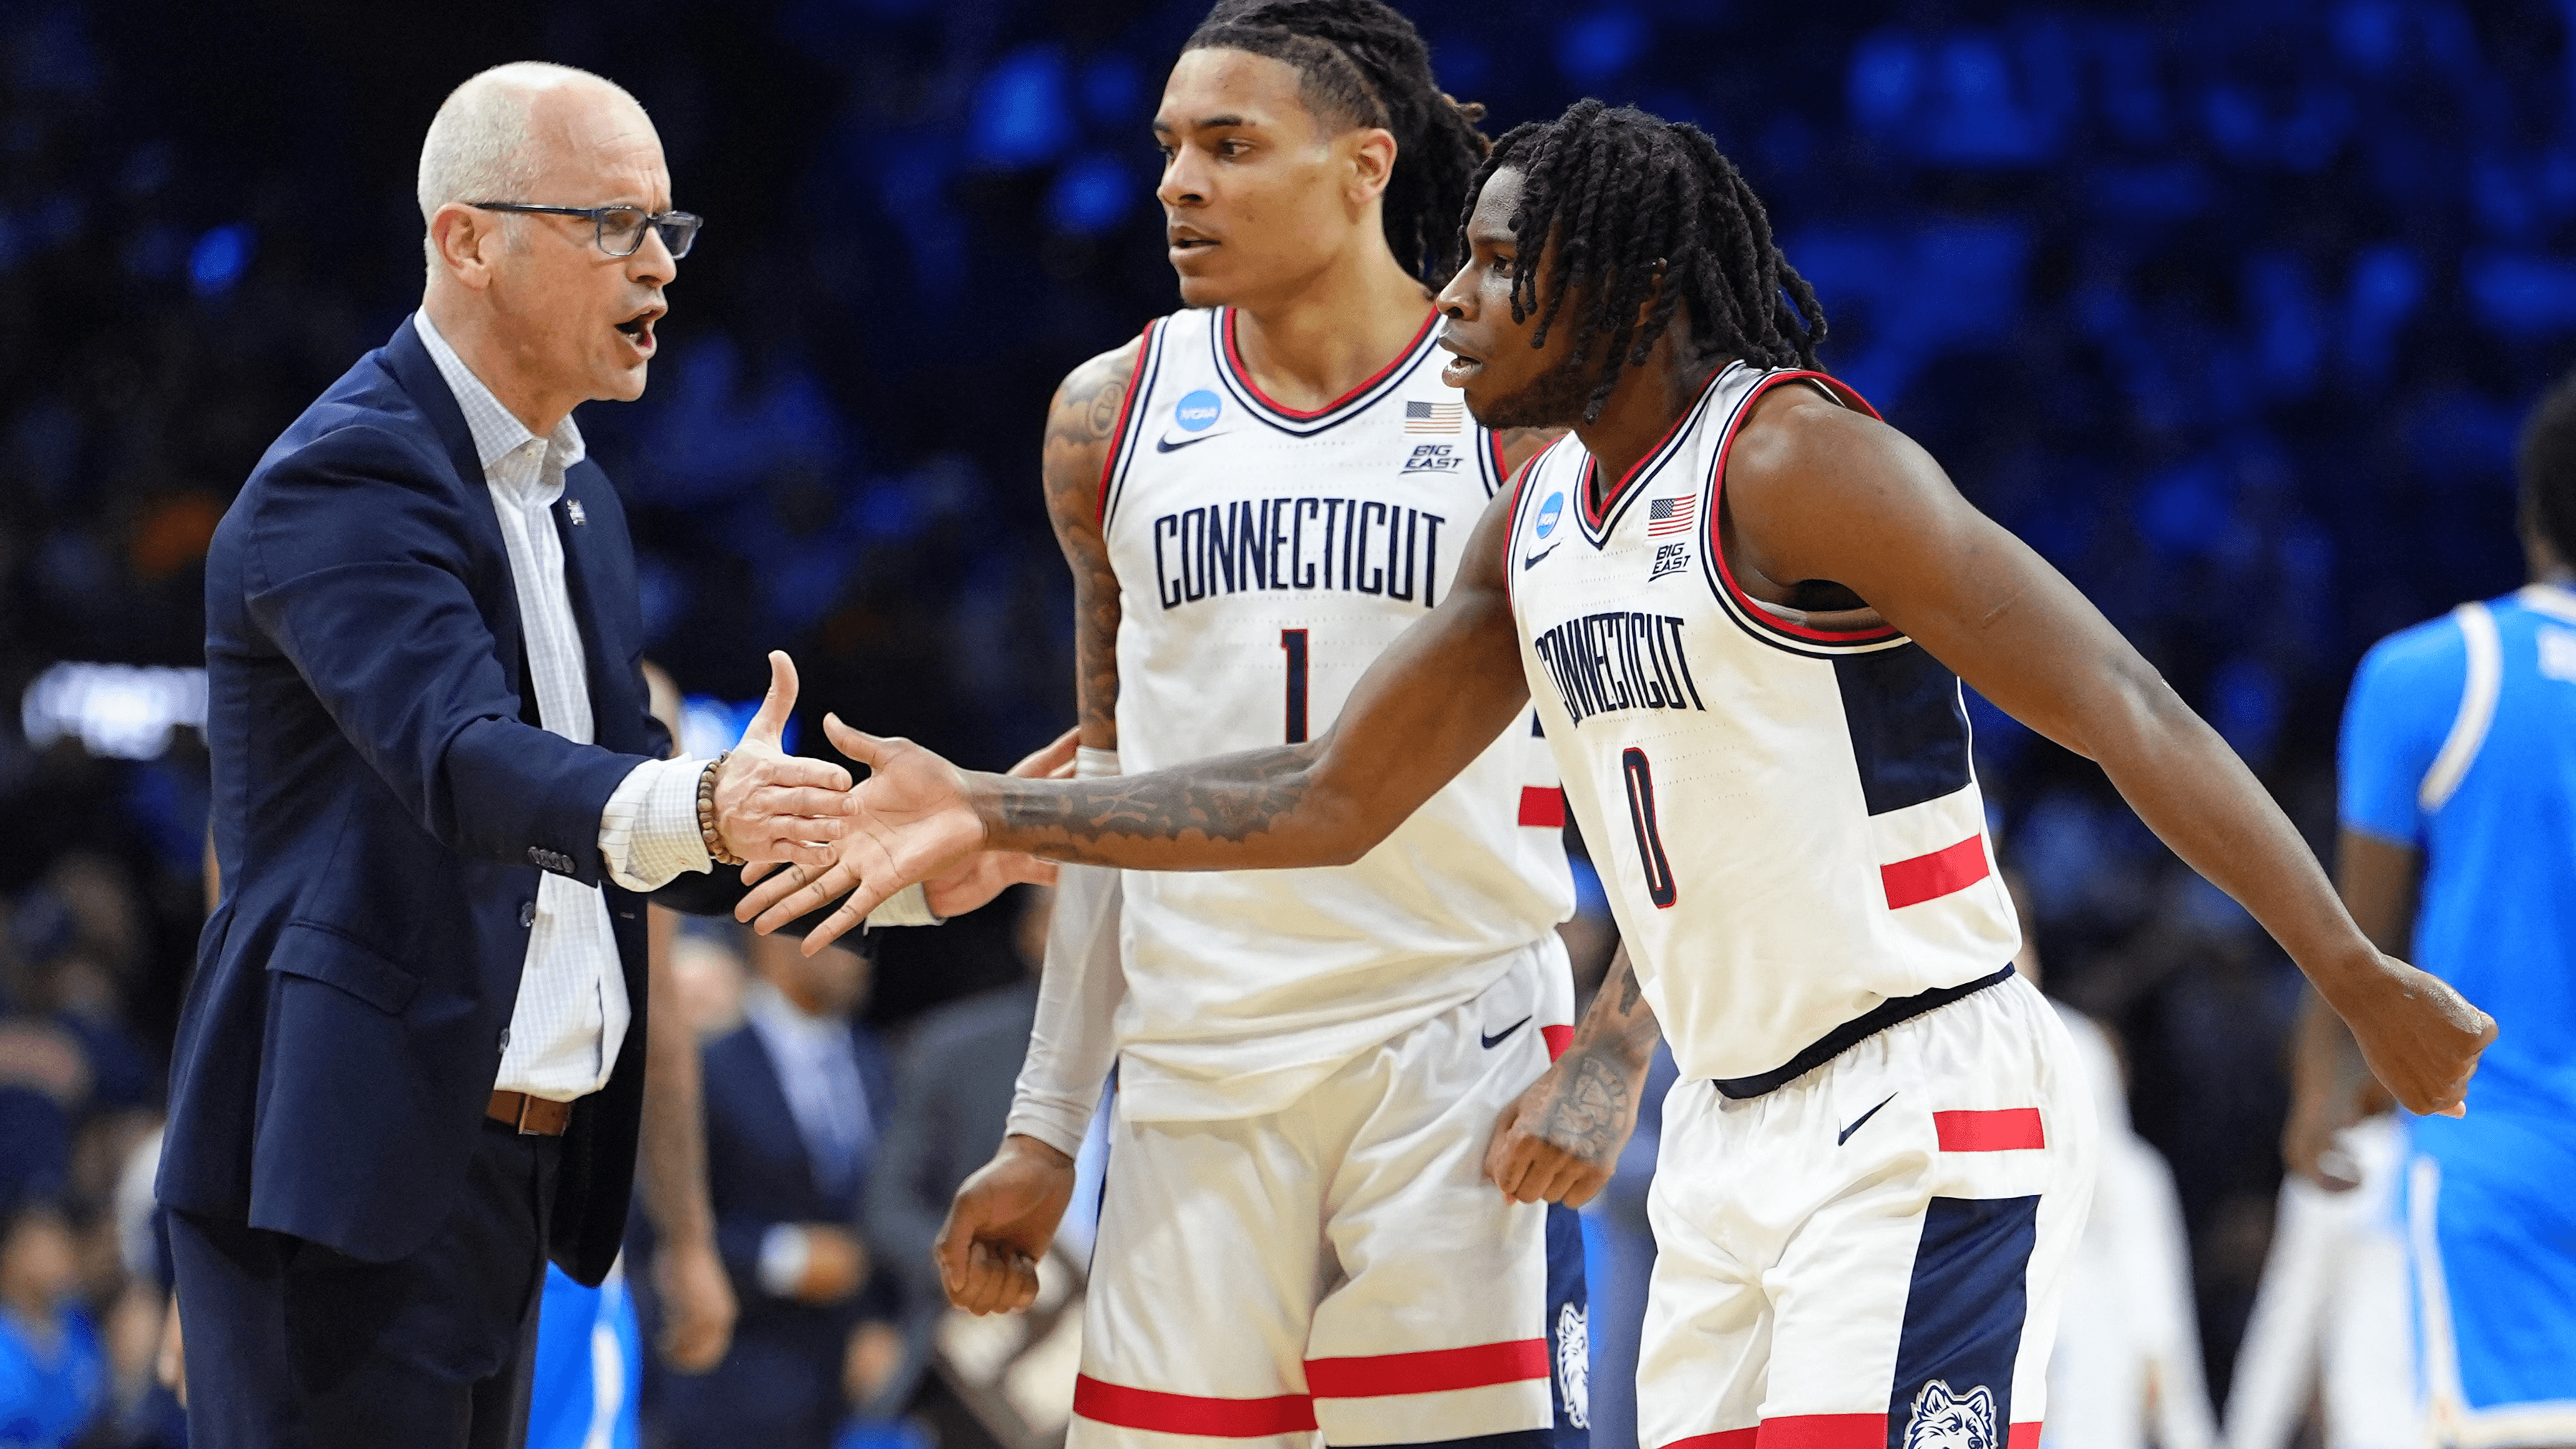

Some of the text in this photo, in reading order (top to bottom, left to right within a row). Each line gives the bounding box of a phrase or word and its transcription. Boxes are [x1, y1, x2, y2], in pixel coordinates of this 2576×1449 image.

[1404, 458, 1463, 469] EAST
[1413, 444, 1453, 457] BIG
[1155, 498, 1445, 610] CONNECTICUT
[1652, 555, 1691, 575] EAST
[1656, 542, 1686, 561] BIG
[1282, 629, 1308, 743] 1
[1535, 612, 1707, 730] CONNECTICUT
[1623, 747, 1677, 909] 0
